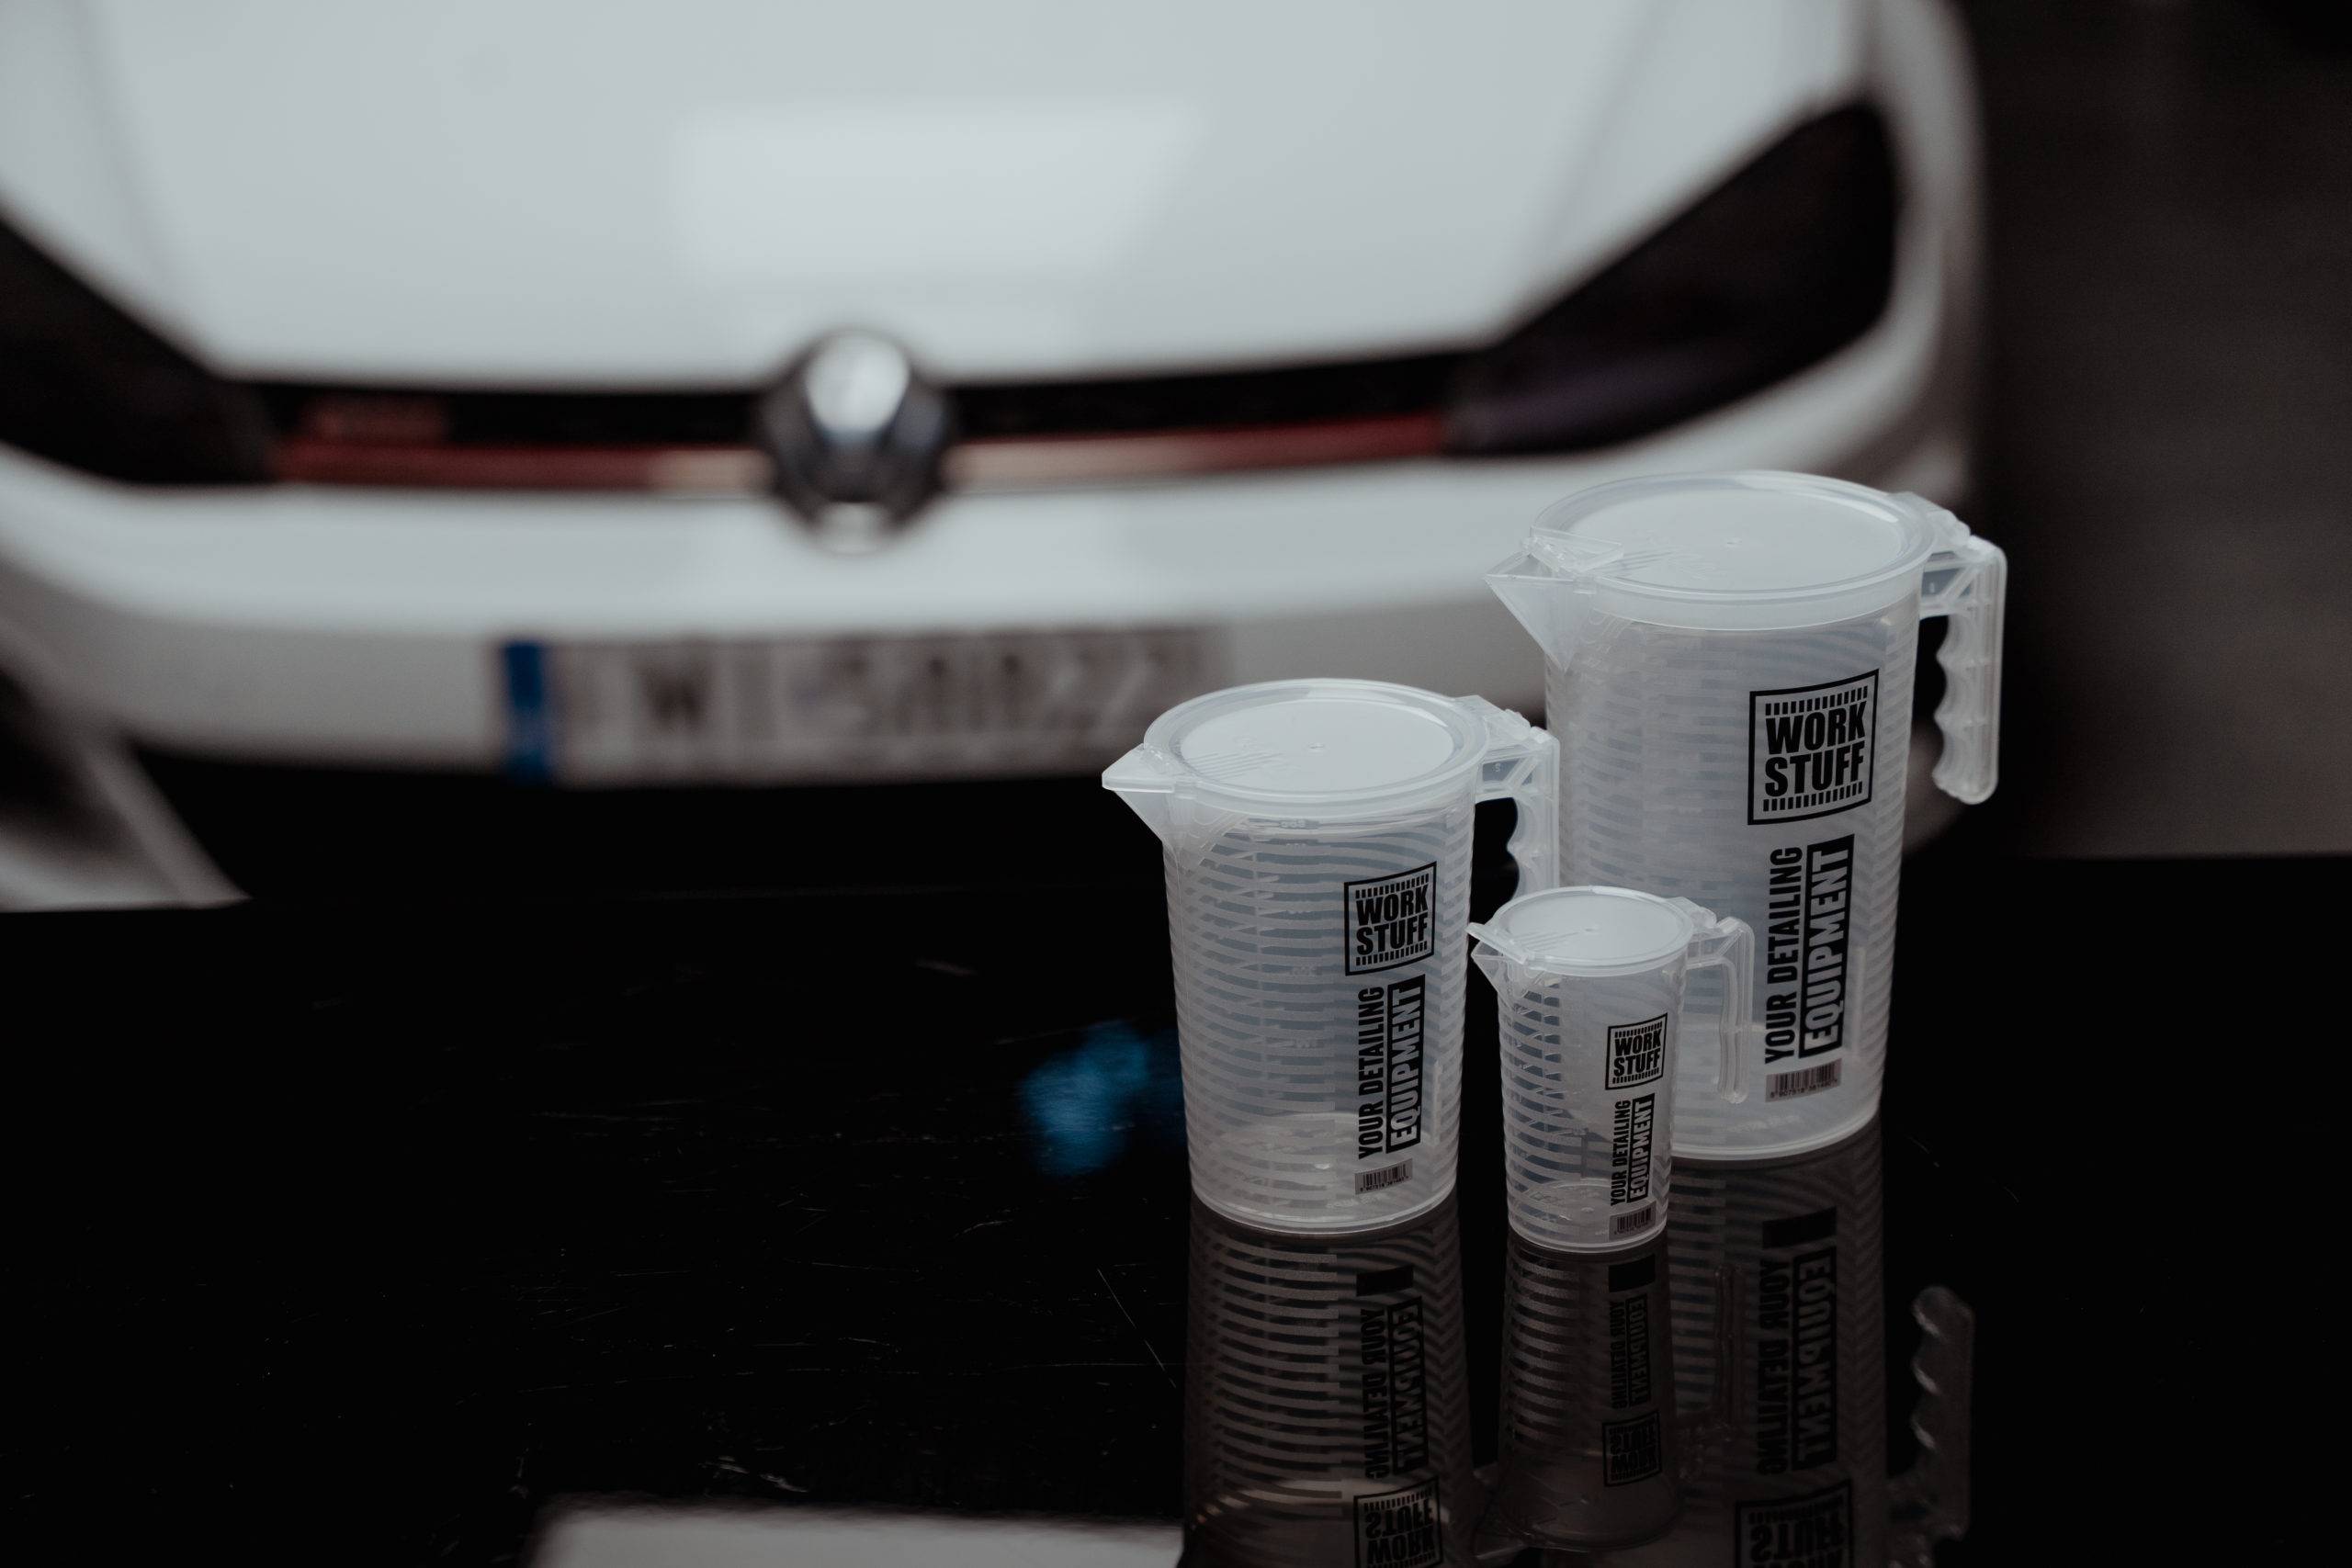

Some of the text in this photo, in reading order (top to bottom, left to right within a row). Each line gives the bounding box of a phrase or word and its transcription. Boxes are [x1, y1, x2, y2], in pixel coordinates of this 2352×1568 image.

[1765, 701, 1867, 754] WORK
[1765, 740, 1865, 797] STUFF
[1356, 885, 1429, 926] WORK
[1356, 912, 1429, 955] STUFF
[1765, 846, 1803, 1064] YOUR DETAILING
[1804, 850, 1849, 1050] EQUIPMENT
[1358, 986, 1385, 1160] YOUR DETAILING
[1390, 987, 1421, 1151] EQUIPMENT
[1613, 1048, 1661, 1077] STUFF
[1614, 1029, 1662, 1056] WORK
[1611, 1100, 1631, 1206] YOUR DETAILING
[1629, 1101, 1653, 1200] EQUIPMENT
